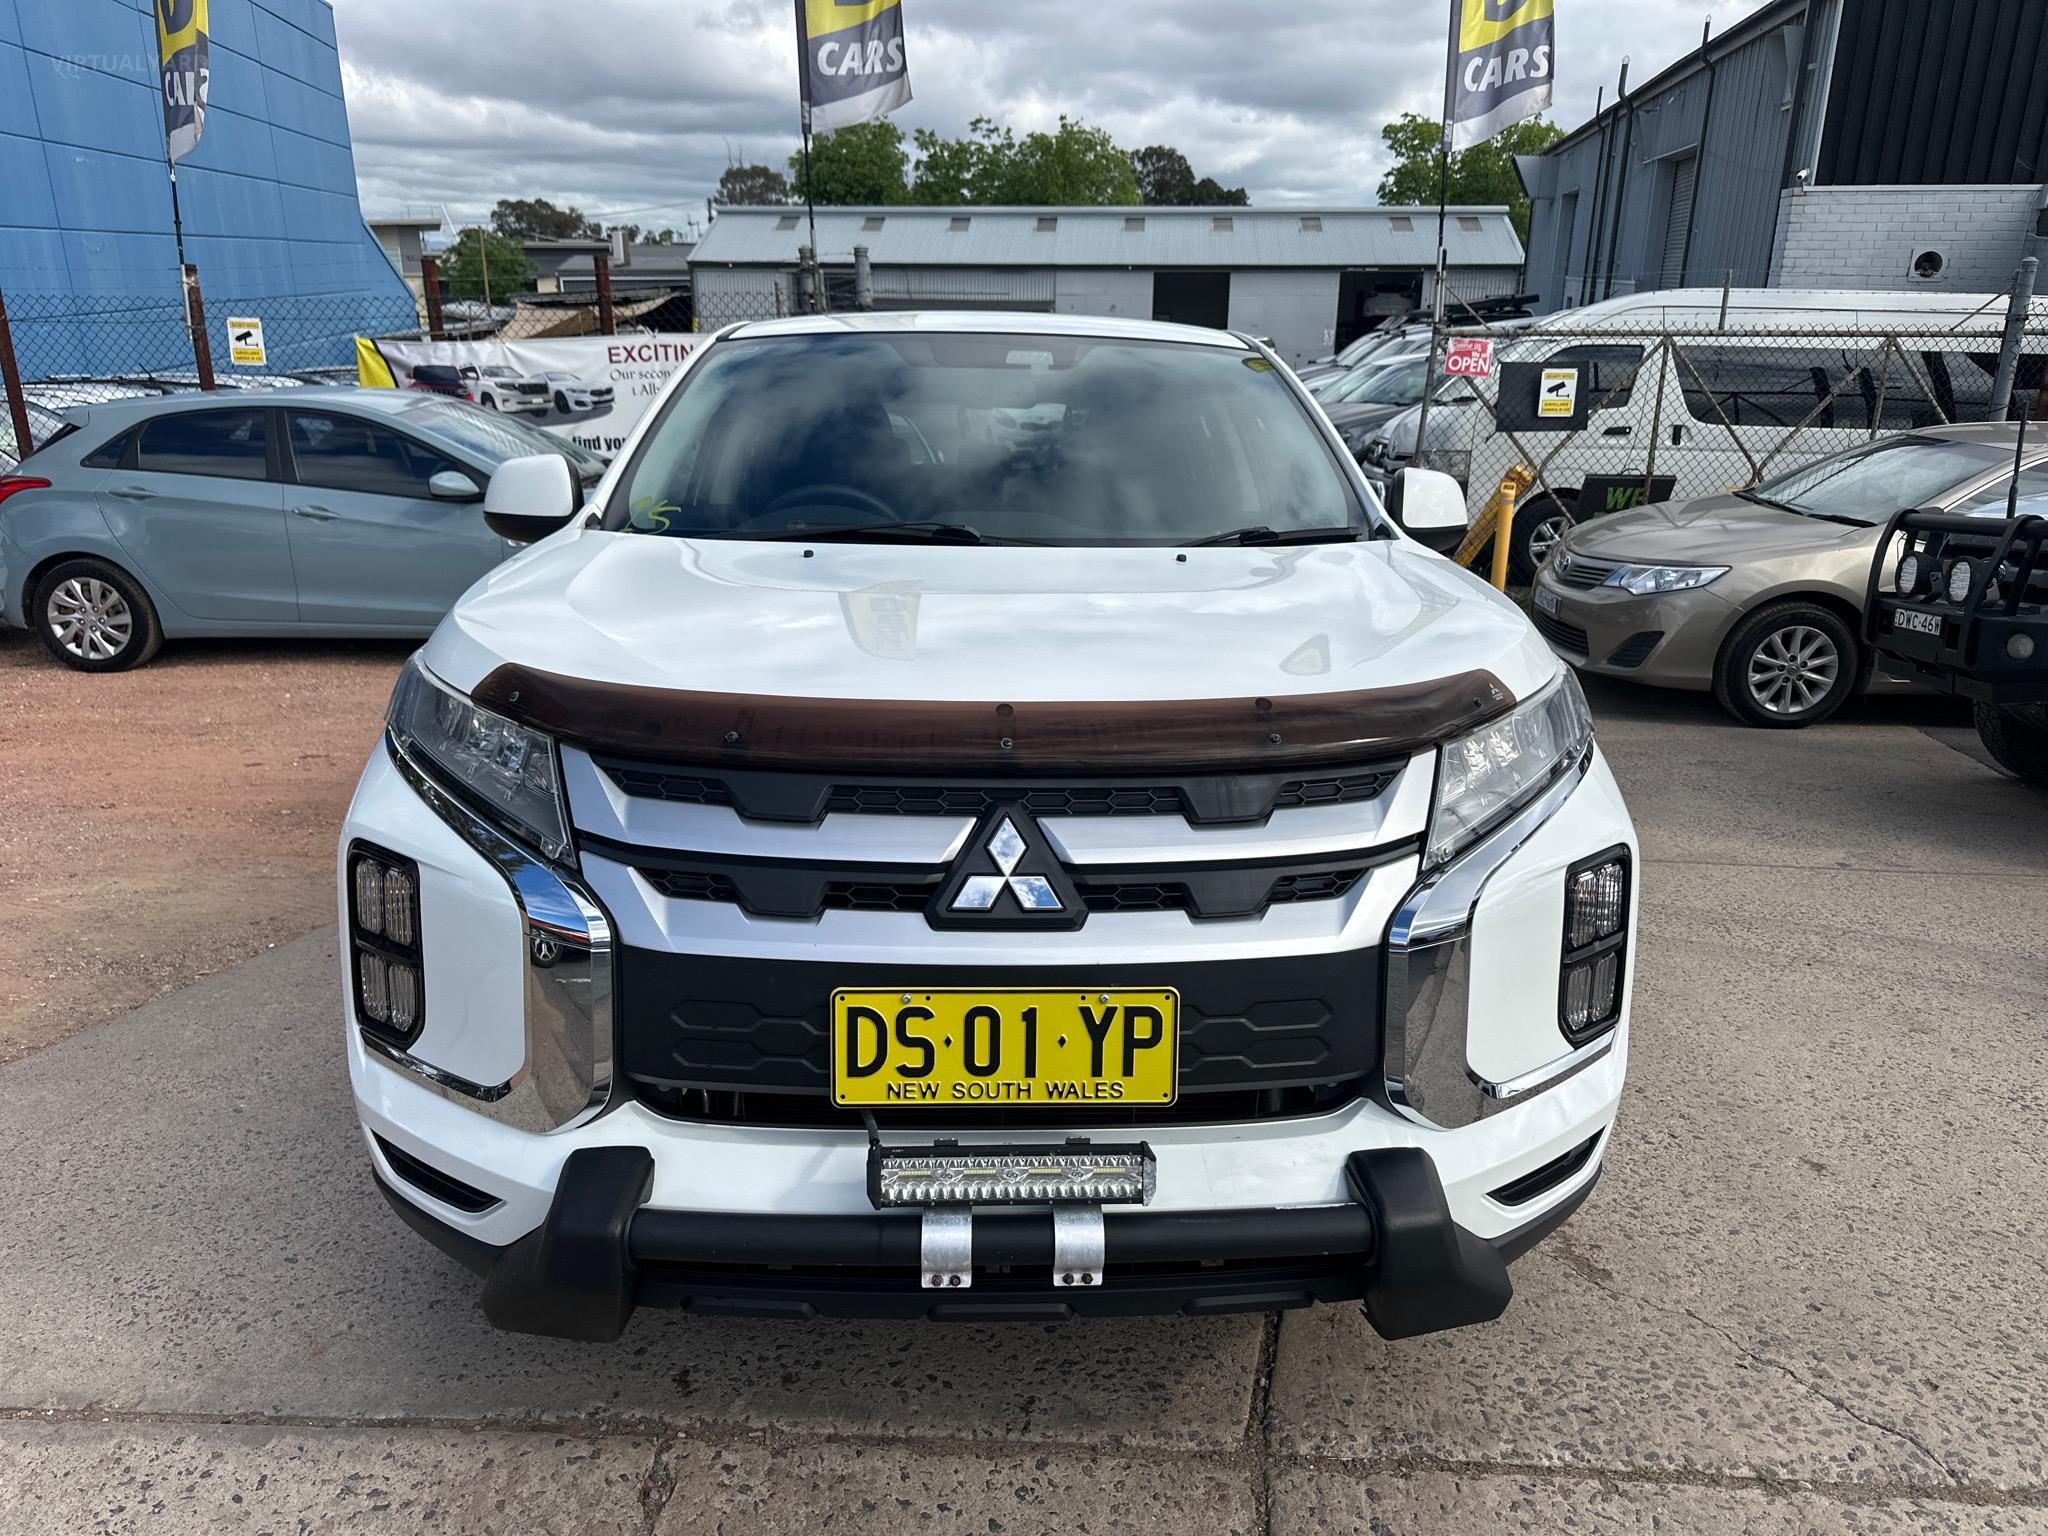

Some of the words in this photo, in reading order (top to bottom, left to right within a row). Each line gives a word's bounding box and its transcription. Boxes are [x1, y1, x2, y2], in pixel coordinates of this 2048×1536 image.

[817, 37, 903, 76] CARS
[1464, 45, 1550, 92] CARS
[1448, 355, 1489, 373] OPEN
[610, 369, 635, 381] Our
[888, 1081, 940, 1100] NEW
[952, 1081, 1032, 1100] SOUTH
[1046, 1080, 1125, 1099] WALES
